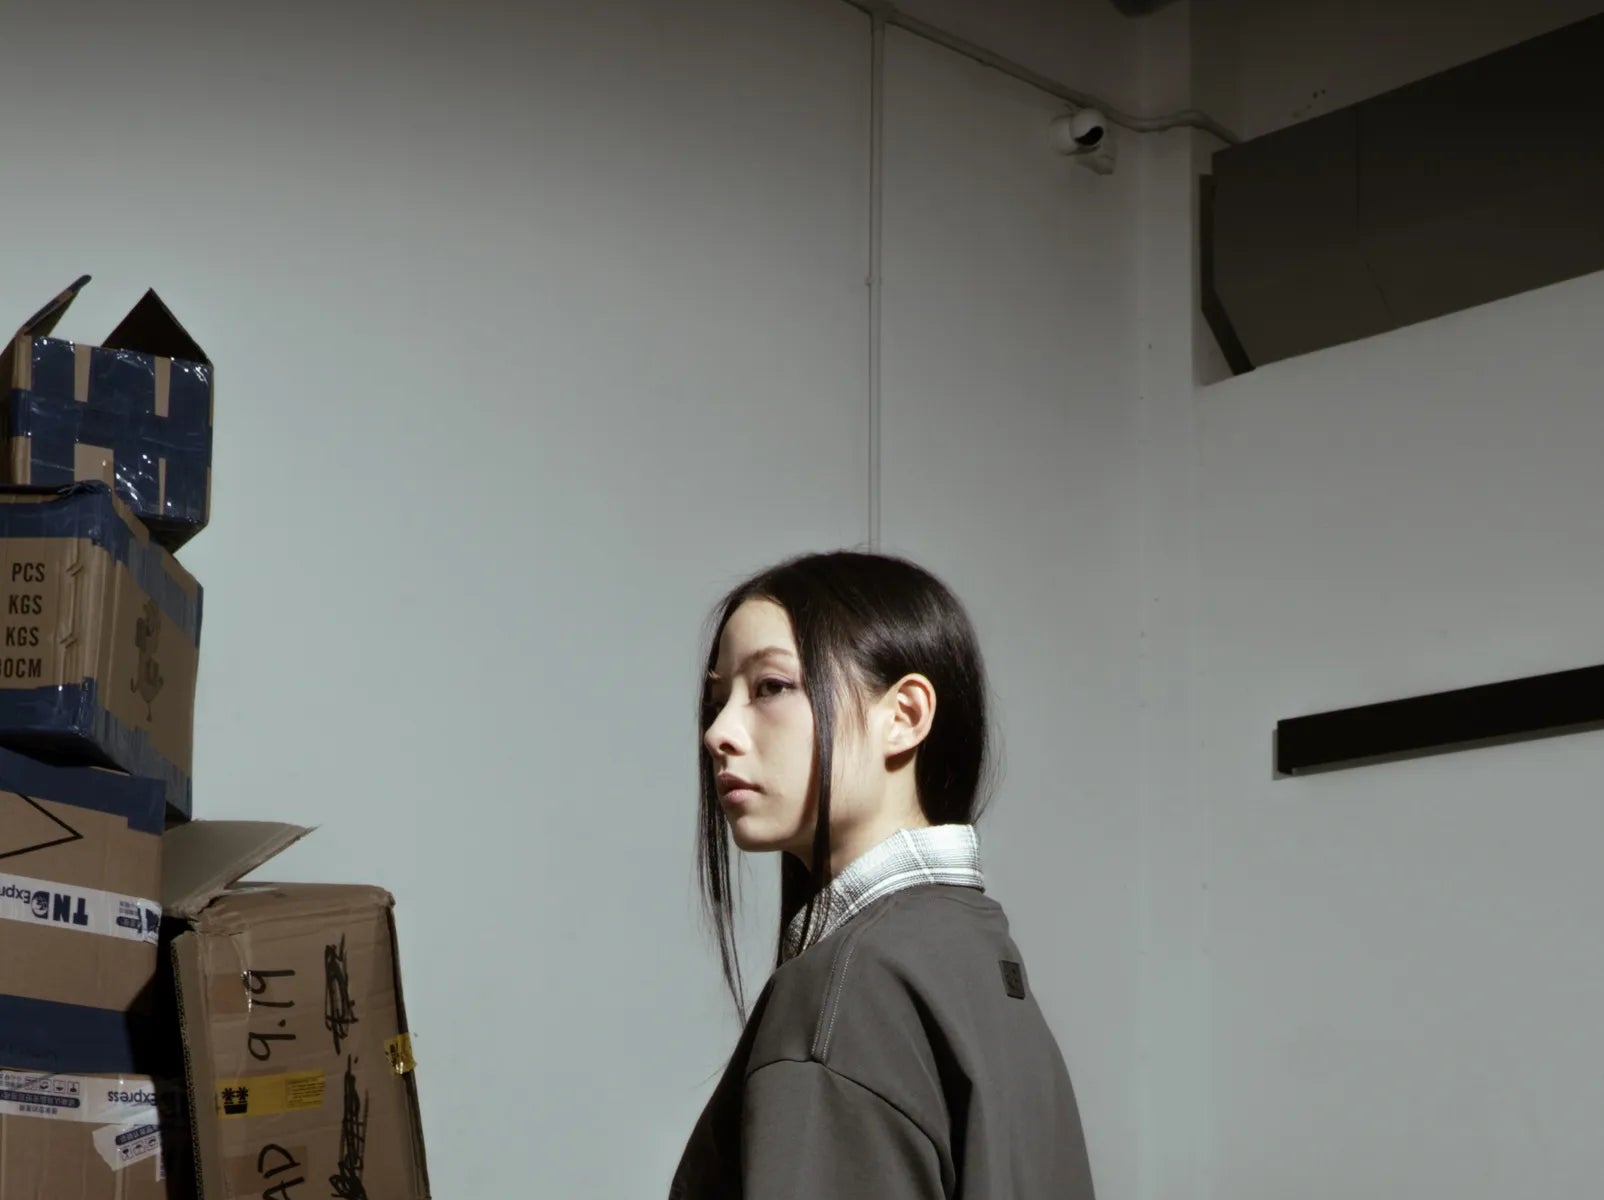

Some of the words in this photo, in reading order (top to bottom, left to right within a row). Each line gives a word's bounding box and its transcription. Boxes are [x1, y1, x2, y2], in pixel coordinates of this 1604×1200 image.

[11, 562, 46, 583] PCS
[8, 594, 43, 615] KGS
[5, 626, 40, 647] KGS
[247, 969, 297, 1061] 9.19
